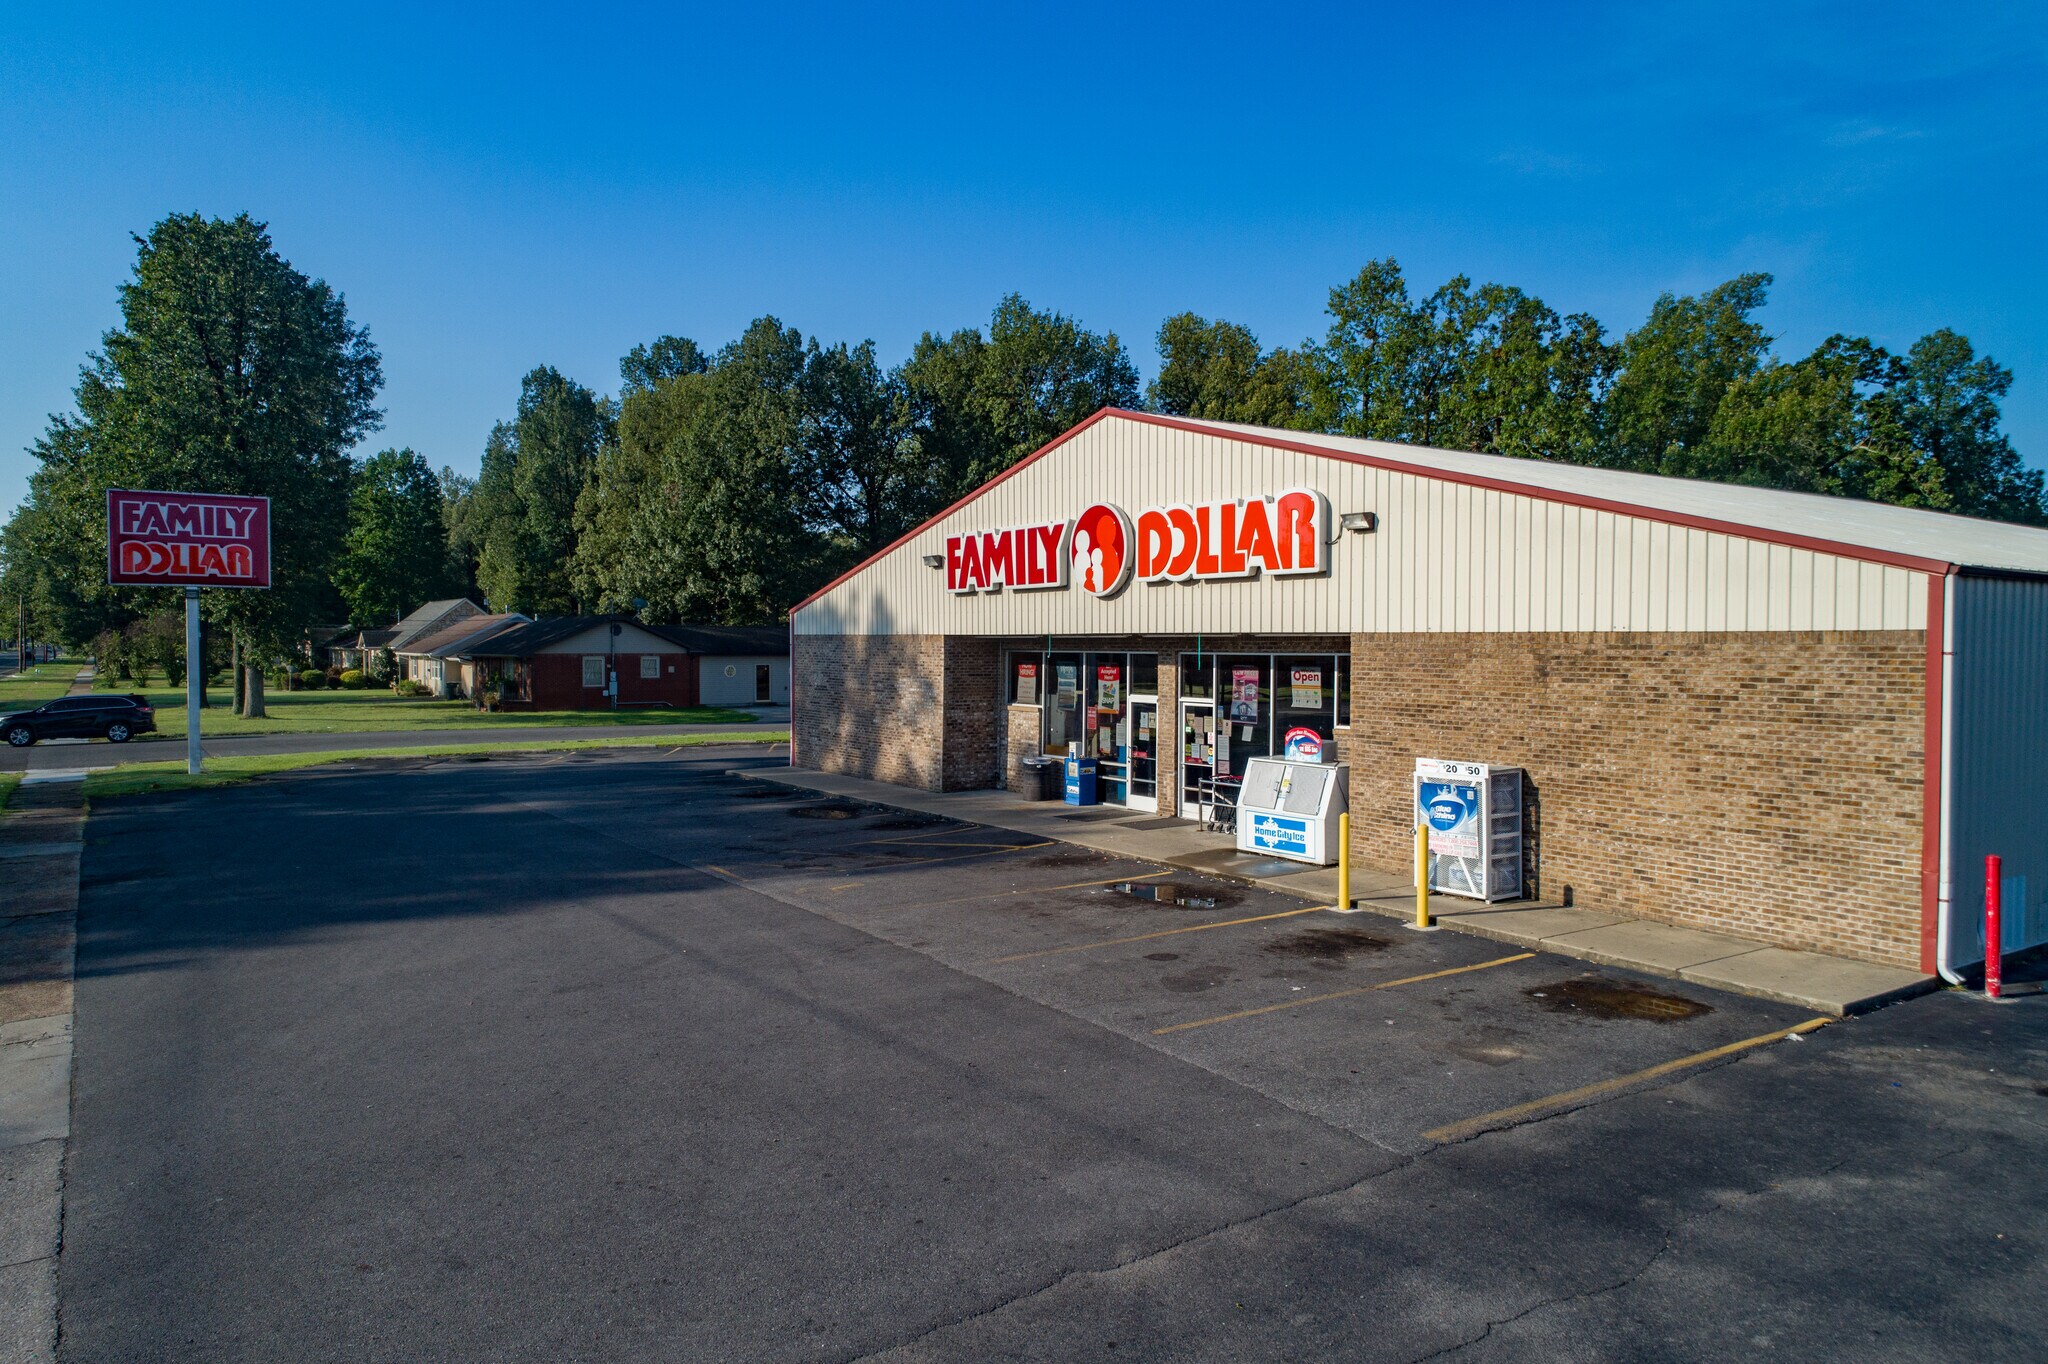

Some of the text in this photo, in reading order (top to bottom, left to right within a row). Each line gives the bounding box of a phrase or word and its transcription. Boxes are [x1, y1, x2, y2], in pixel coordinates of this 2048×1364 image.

[119, 501, 257, 539] FAMILY
[120, 541, 252, 578] DOLLAR
[947, 491, 1317, 591] FAMILY DOLLAR
[1293, 671, 1319, 684] Open
[1255, 826, 1305, 841] Home City Ice
